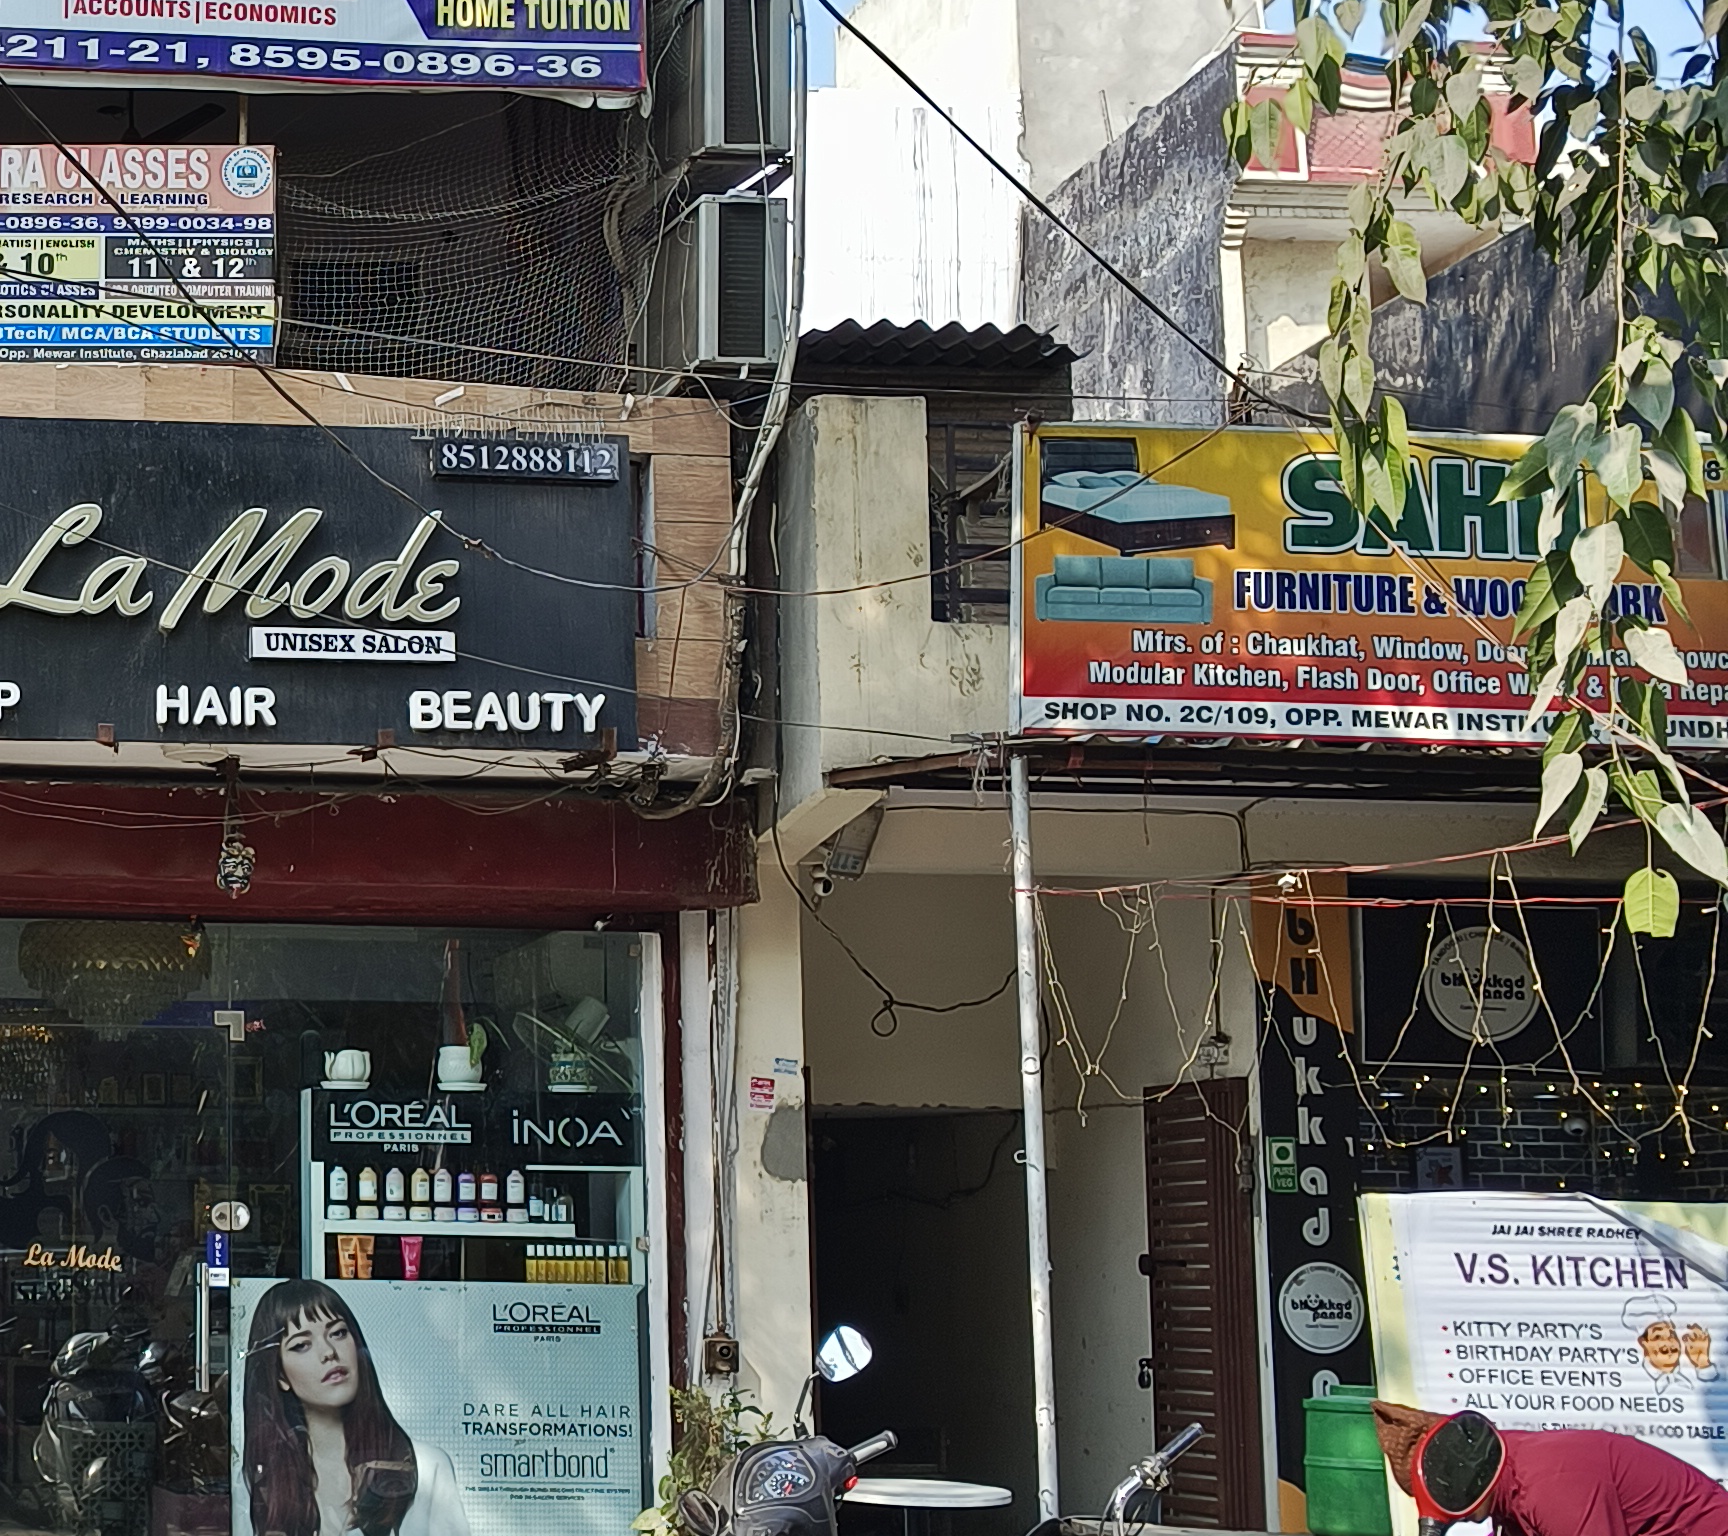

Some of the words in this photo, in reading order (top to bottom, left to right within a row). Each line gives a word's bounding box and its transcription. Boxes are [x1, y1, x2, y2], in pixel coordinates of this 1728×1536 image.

[229, 42, 603, 78] 8595-0896-36
[56, 148, 210, 190] CLASSES
[0, 193, 93, 205] RESEARCH
[120, 194, 208, 205] LEARNING
[181, 258, 202, 278] &
[62, 326, 154, 341] MCA/BCA
[159, 326, 261, 341] STUDENTS
[33, 347, 77, 359] Mewar
[140, 347, 208, 359] Ghaziabad
[158, 507, 461, 632] Mode
[1235, 570, 1417, 614] FURNITURE
[264, 632, 356, 653] UNISEX
[362, 634, 443, 655] SALON
[1133, 630, 1193, 654] Mfrs.
[1201, 632, 1223, 654] of
[1247, 632, 1366, 661] Chaukhat,
[1373, 637, 1469, 663] Window,
[1089, 661, 1185, 686] Modular
[1194, 664, 1289, 692] Kitchen,
[1297, 667, 1359, 691] Flash
[1367, 670, 1426, 696] Door,
[1433, 672, 1501, 696] Office
[1585, 676, 1605, 699] &
[156, 684, 277, 727] HAIR
[408, 689, 607, 733] BEAUTY
[1044, 702, 1117, 721] SHOP
[1126, 704, 1172, 723] NO.
[1179, 705, 1277, 729] 2C/109,
[1285, 708, 1343, 728] OPP.
[1352, 710, 1448, 731] MEWAR
[332, 1131, 470, 1142] PROFESSIONNEL
[383, 1143, 420, 1153] PARIS
[1492, 1224, 1511, 1237] JAI
[1515, 1225, 1534, 1237] JAI
[1538, 1226, 1582, 1239] SHREE
[1587, 1227, 1643, 1241] RADHEY
[23, 1243, 56, 1267] La
[60, 1244, 123, 1272] Mode
[1454, 1252, 1520, 1285] V.S.
[1531, 1255, 1689, 1290] KITCHEN
[494, 1324, 601, 1334] PROFESSIONNEL
[1453, 1320, 1511, 1338] KITTY
[1518, 1322, 1603, 1341] PARTY'S
[1457, 1346, 1553, 1363] BIRTHDAY
[1559, 1347, 1639, 1365] PARTY'S
[1459, 1368, 1534, 1386] OFFICE
[1540, 1370, 1622, 1388] EVENTS
[463, 1403, 520, 1418] DARE
[531, 1403, 570, 1418] ALL
[580, 1405, 632, 1419] HAIR
[1465, 1393, 1497, 1410] ALL
[1501, 1394, 1555, 1411] YOUR
[1561, 1396, 1614, 1412] FOOD
[1620, 1397, 1684, 1414] NEEDS
[462, 1422, 633, 1439] TRANSFORMATIONS!
[480, 1447, 609, 1479] smartbond
